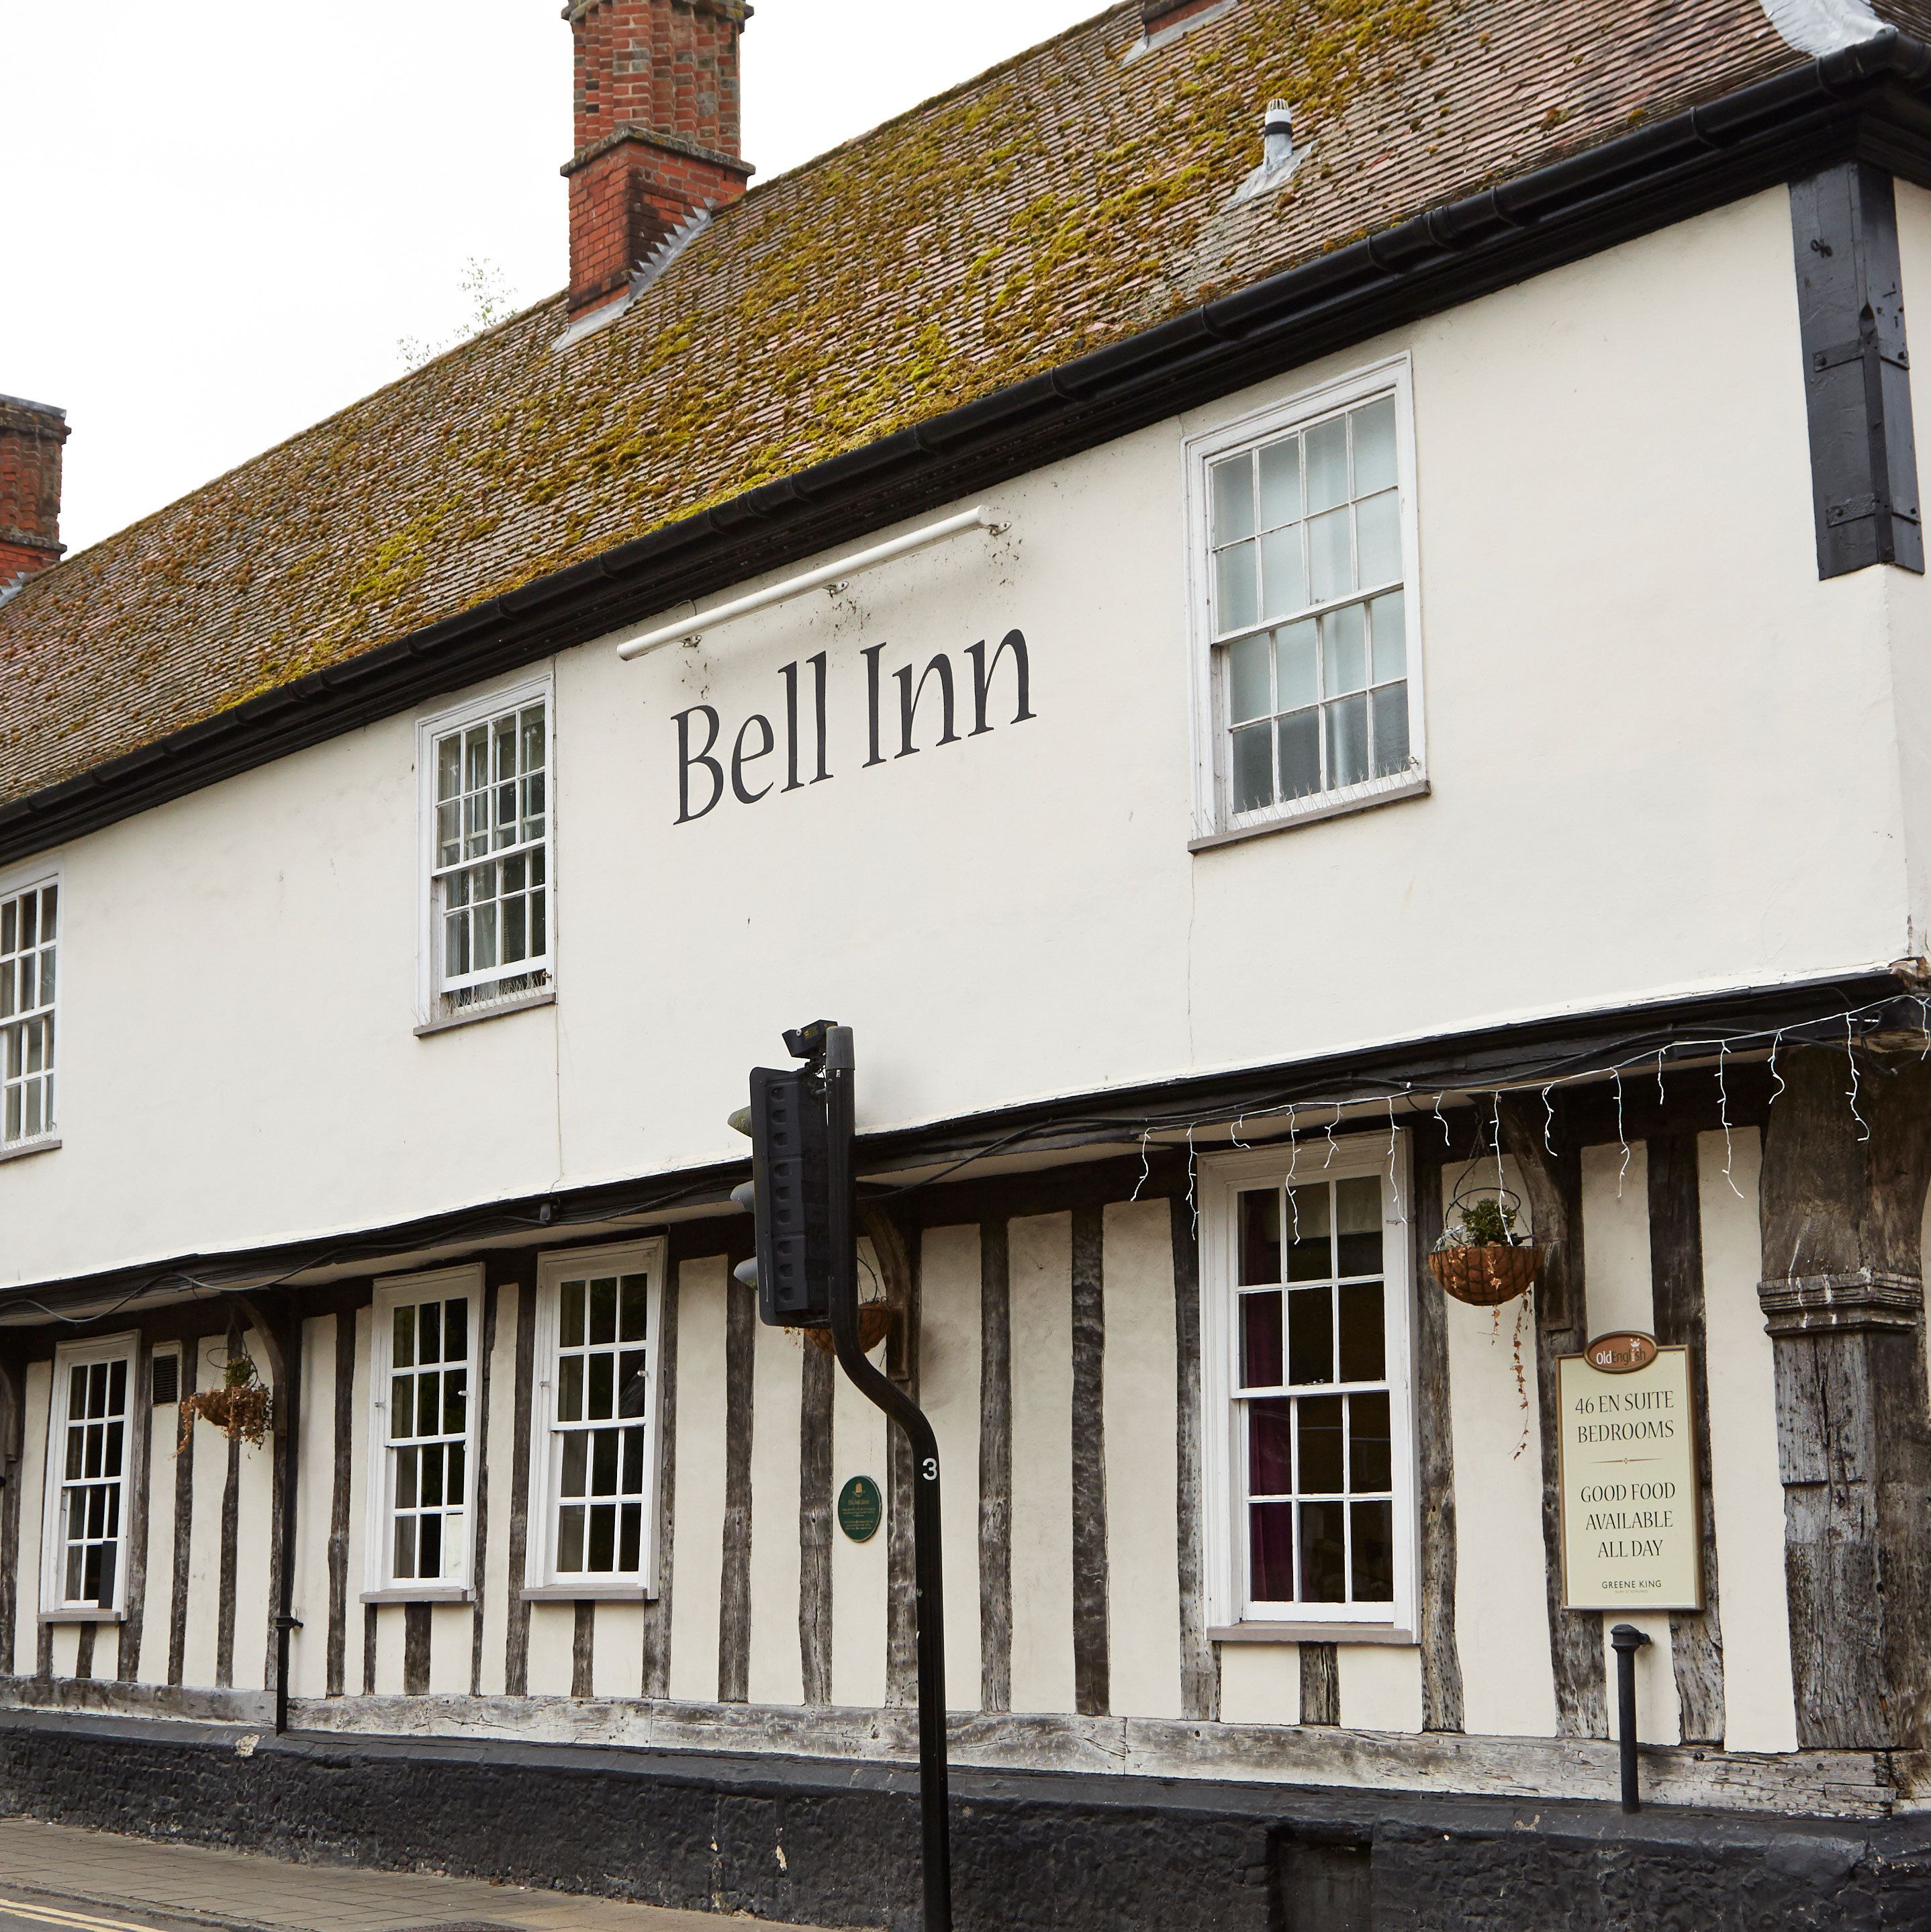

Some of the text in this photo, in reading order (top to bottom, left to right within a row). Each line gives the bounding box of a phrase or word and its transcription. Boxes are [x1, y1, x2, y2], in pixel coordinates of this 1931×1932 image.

[670, 629, 1037, 826] Bell Inn
[1575, 1390, 1675, 1414] 46 EN SUITE
[1577, 1420, 1674, 1443] BEDROOMS
[923, 1457, 937, 1481] 3
[1581, 1481, 1675, 1503] GOOD FOOD
[1585, 1510, 1673, 1530] AVAILABLE
[1597, 1539, 1663, 1558] ALL DAY
[1601, 1579, 1662, 1589] GREENE KING
